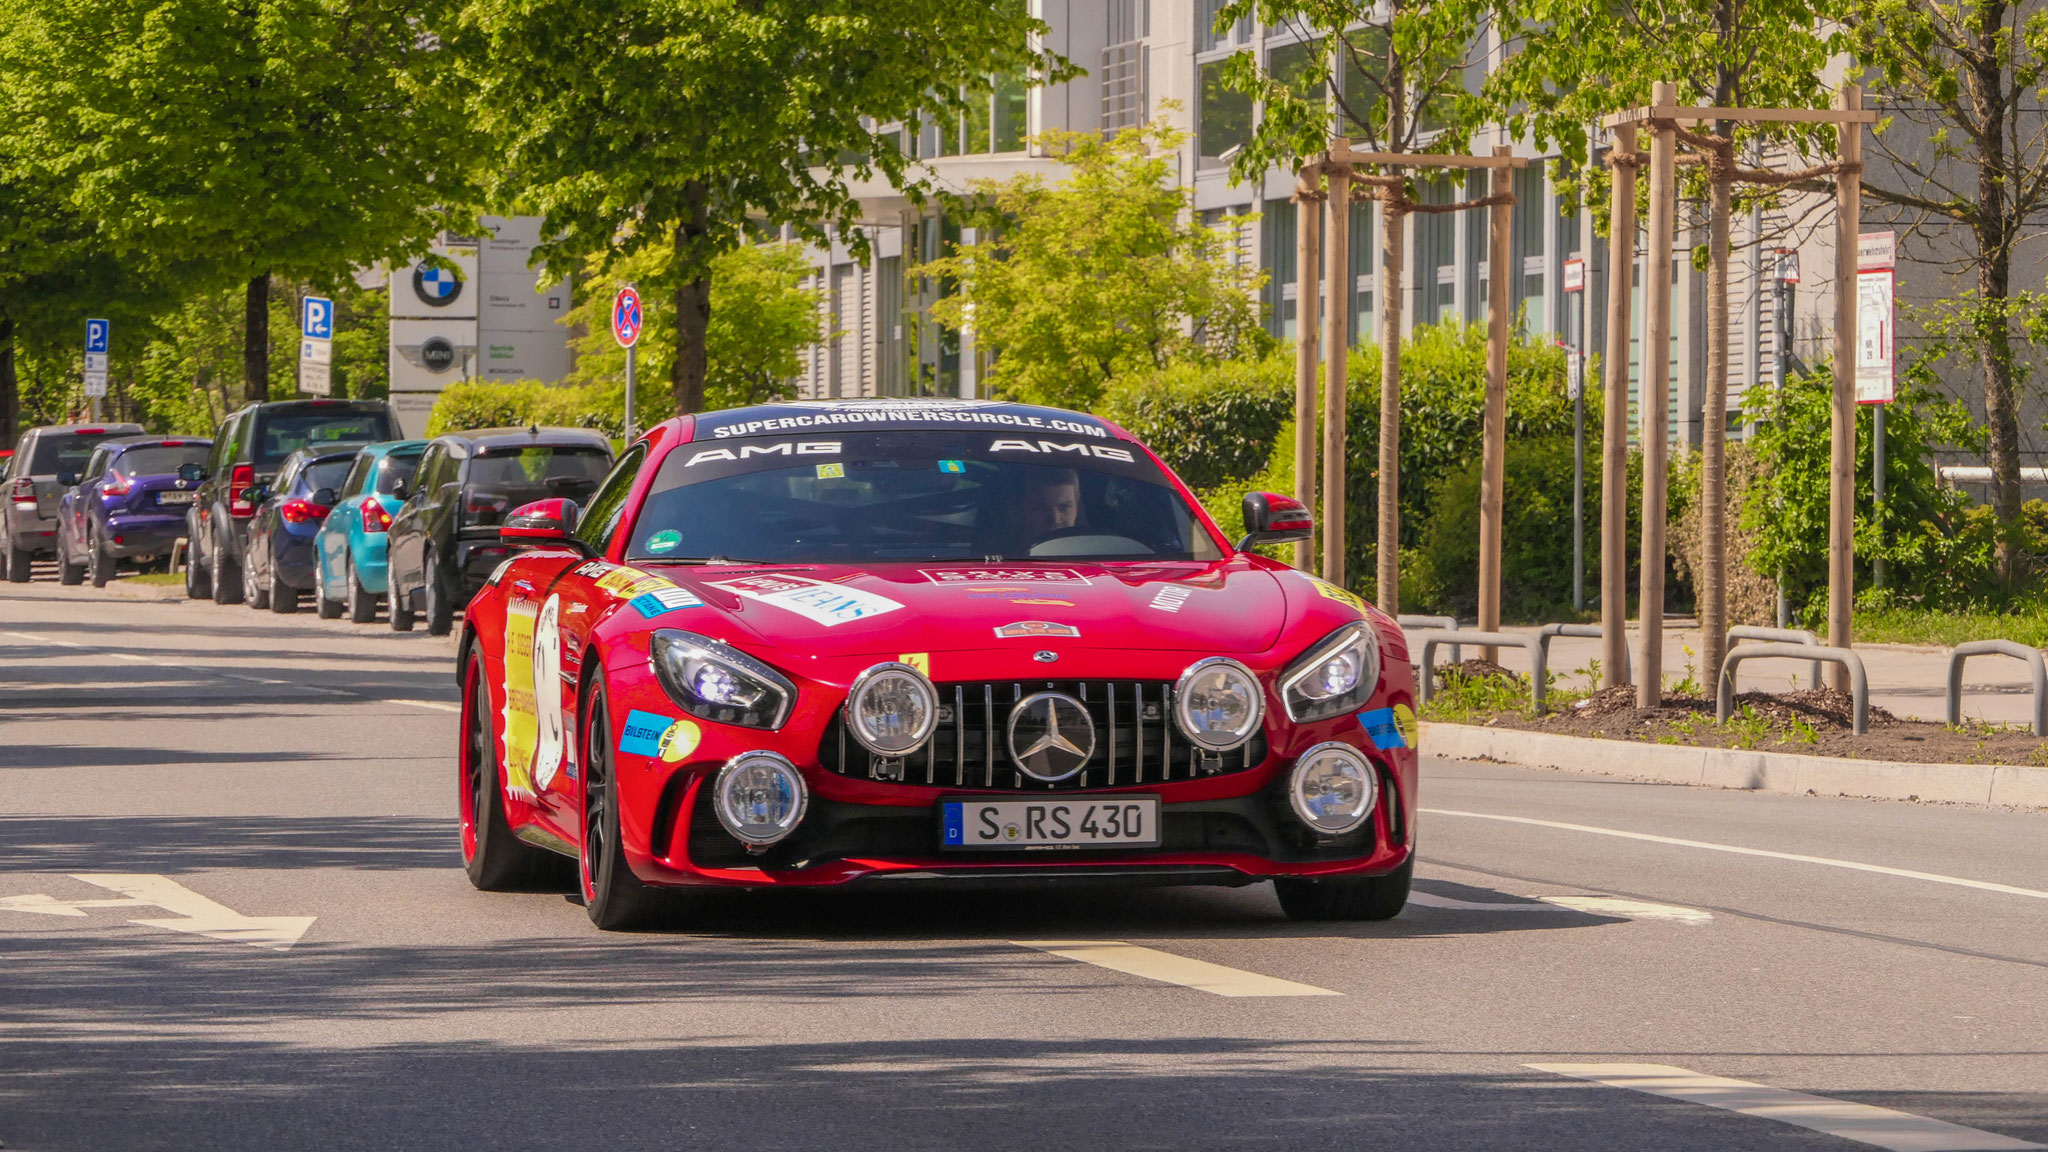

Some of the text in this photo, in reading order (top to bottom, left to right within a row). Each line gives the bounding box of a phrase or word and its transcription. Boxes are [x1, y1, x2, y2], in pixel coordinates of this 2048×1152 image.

[307, 302, 325, 334] P
[88, 323, 103, 349] P
[425, 350, 450, 361] MINI
[713, 411, 1107, 439] SUPERCAROWNERSCIRCLE.COM
[684, 442, 842, 467] AMG
[989, 440, 1135, 463] AMG
[574, 561, 614, 579] AMG
[1149, 586, 1193, 613] MOTOR
[625, 725, 661, 742] BILSTEIN
[979, 806, 1000, 840] S
[1026, 806, 1071, 839] RS
[1080, 804, 1142, 838] 430
